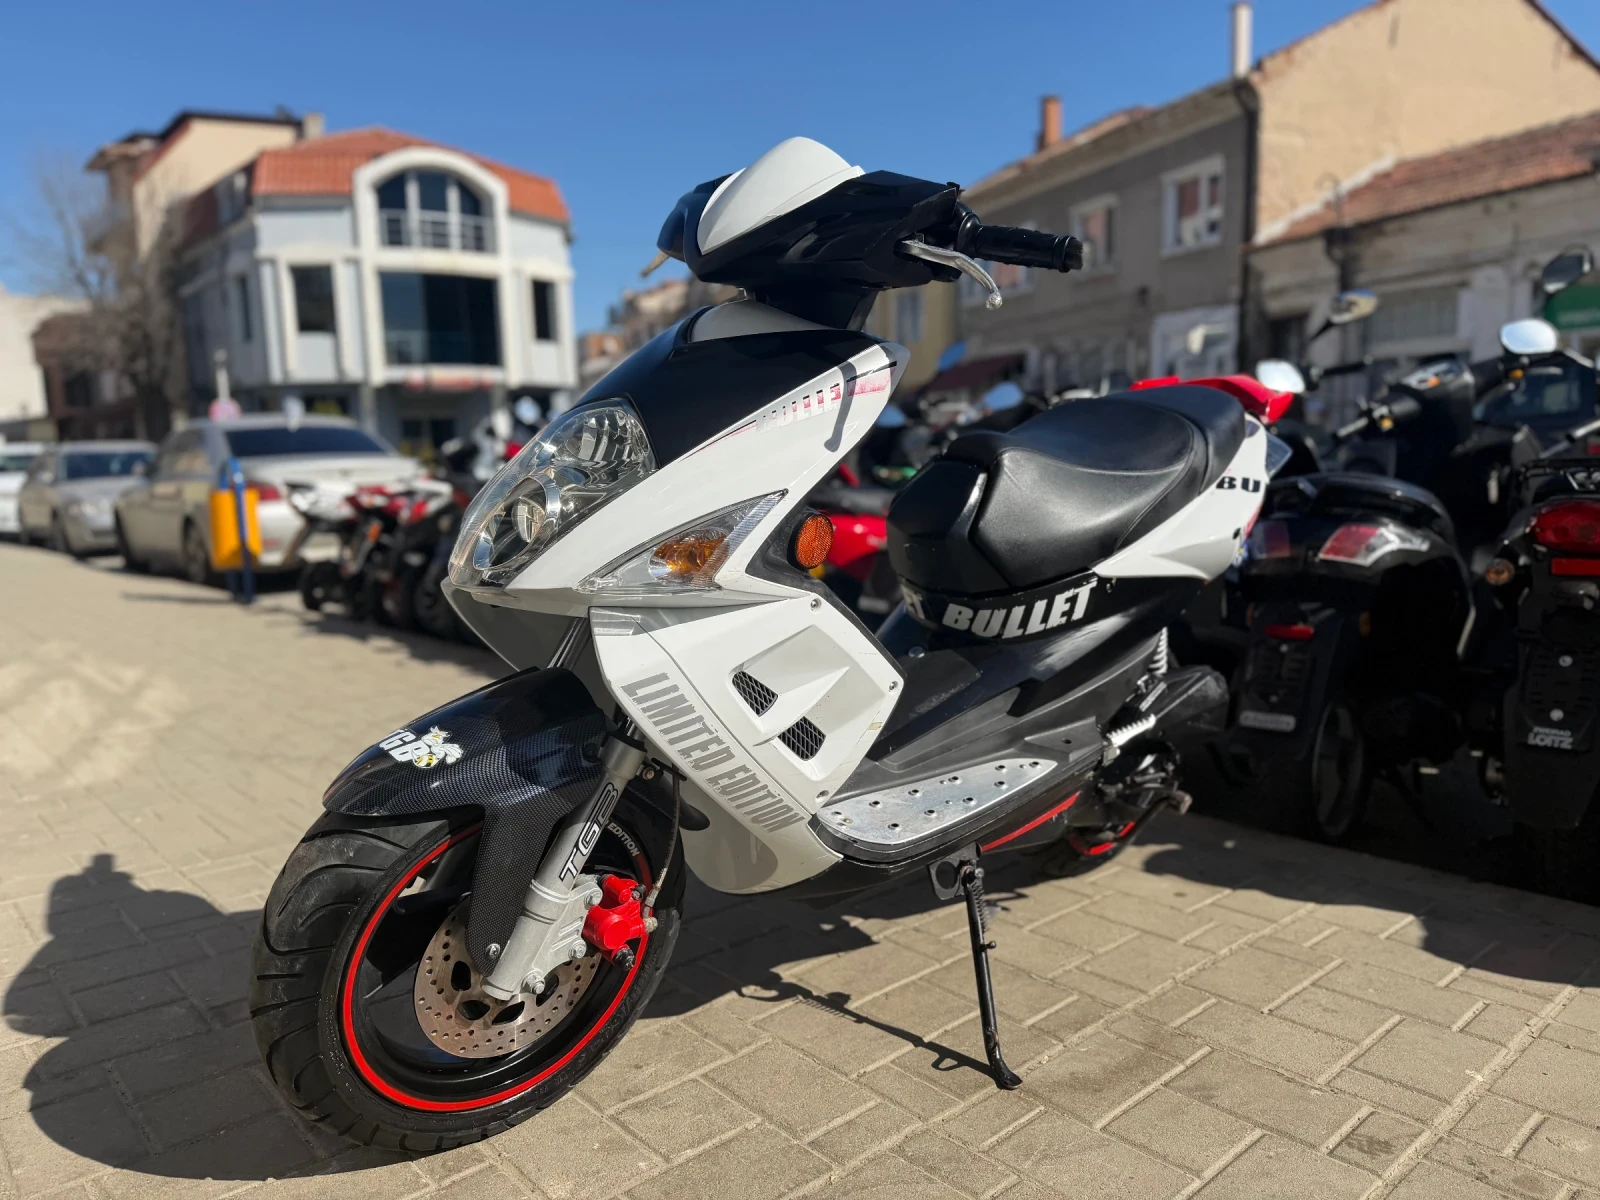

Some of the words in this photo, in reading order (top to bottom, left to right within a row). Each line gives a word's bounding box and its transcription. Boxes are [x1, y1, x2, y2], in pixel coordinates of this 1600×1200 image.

[942, 577, 1098, 639] BULLET
[620, 672, 736, 772] LIMITED
[704, 764, 806, 833] EDITION
[558, 781, 619, 882] TGB
[607, 822, 640, 857] EDITION
